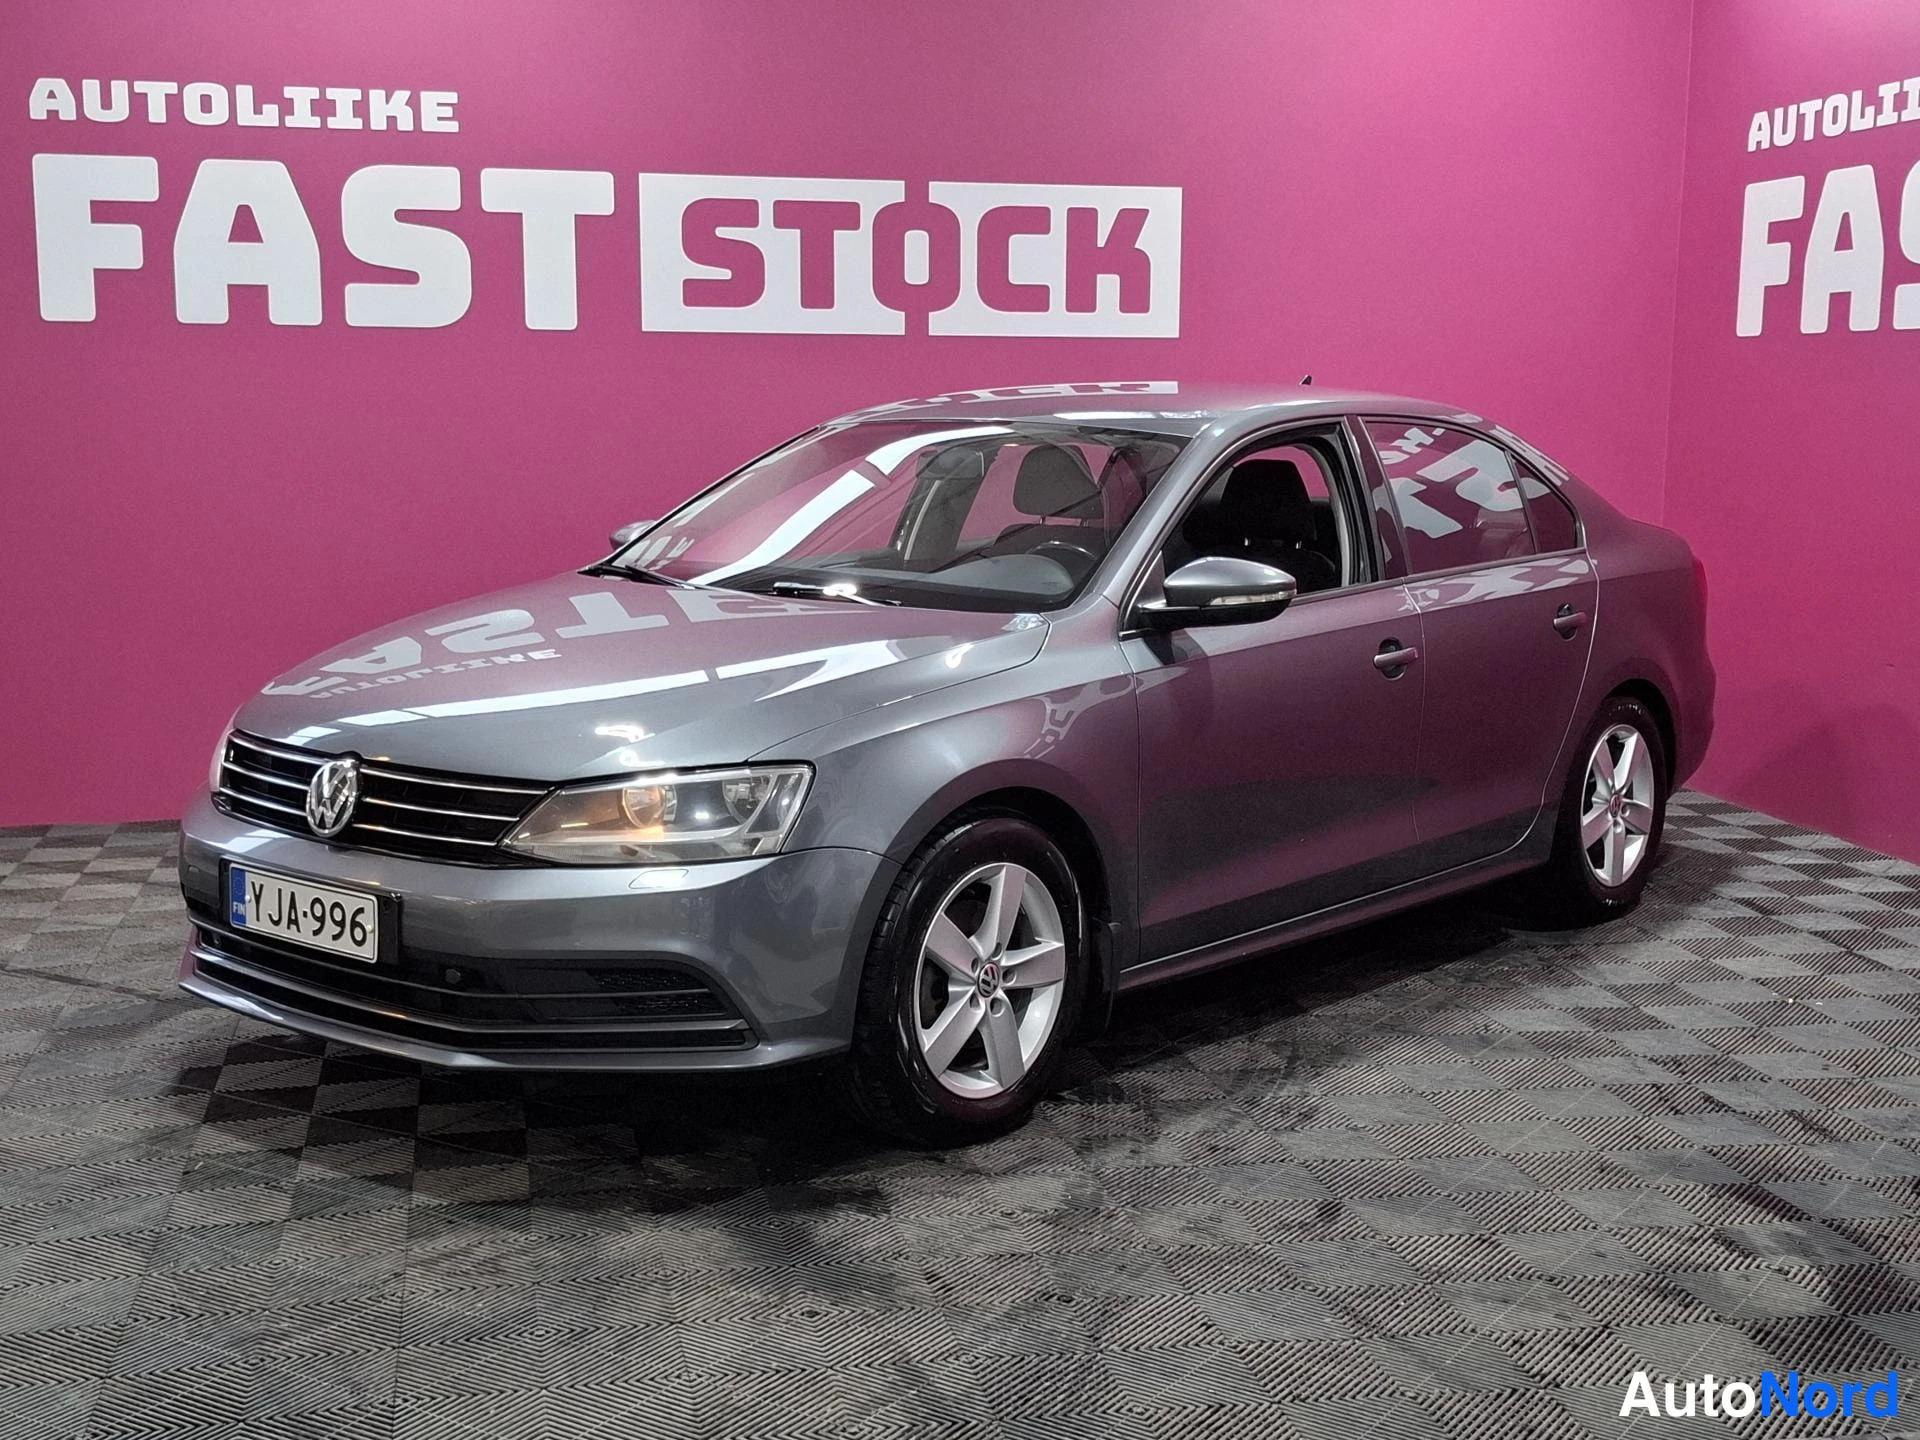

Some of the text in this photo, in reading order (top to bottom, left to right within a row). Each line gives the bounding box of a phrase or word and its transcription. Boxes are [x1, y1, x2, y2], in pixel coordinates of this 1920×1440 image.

[28, 77, 460, 133] AUTOLIIKE
[31, 153, 1153, 331] FAST STOCK
[250, 880, 368, 948] YJA-996
